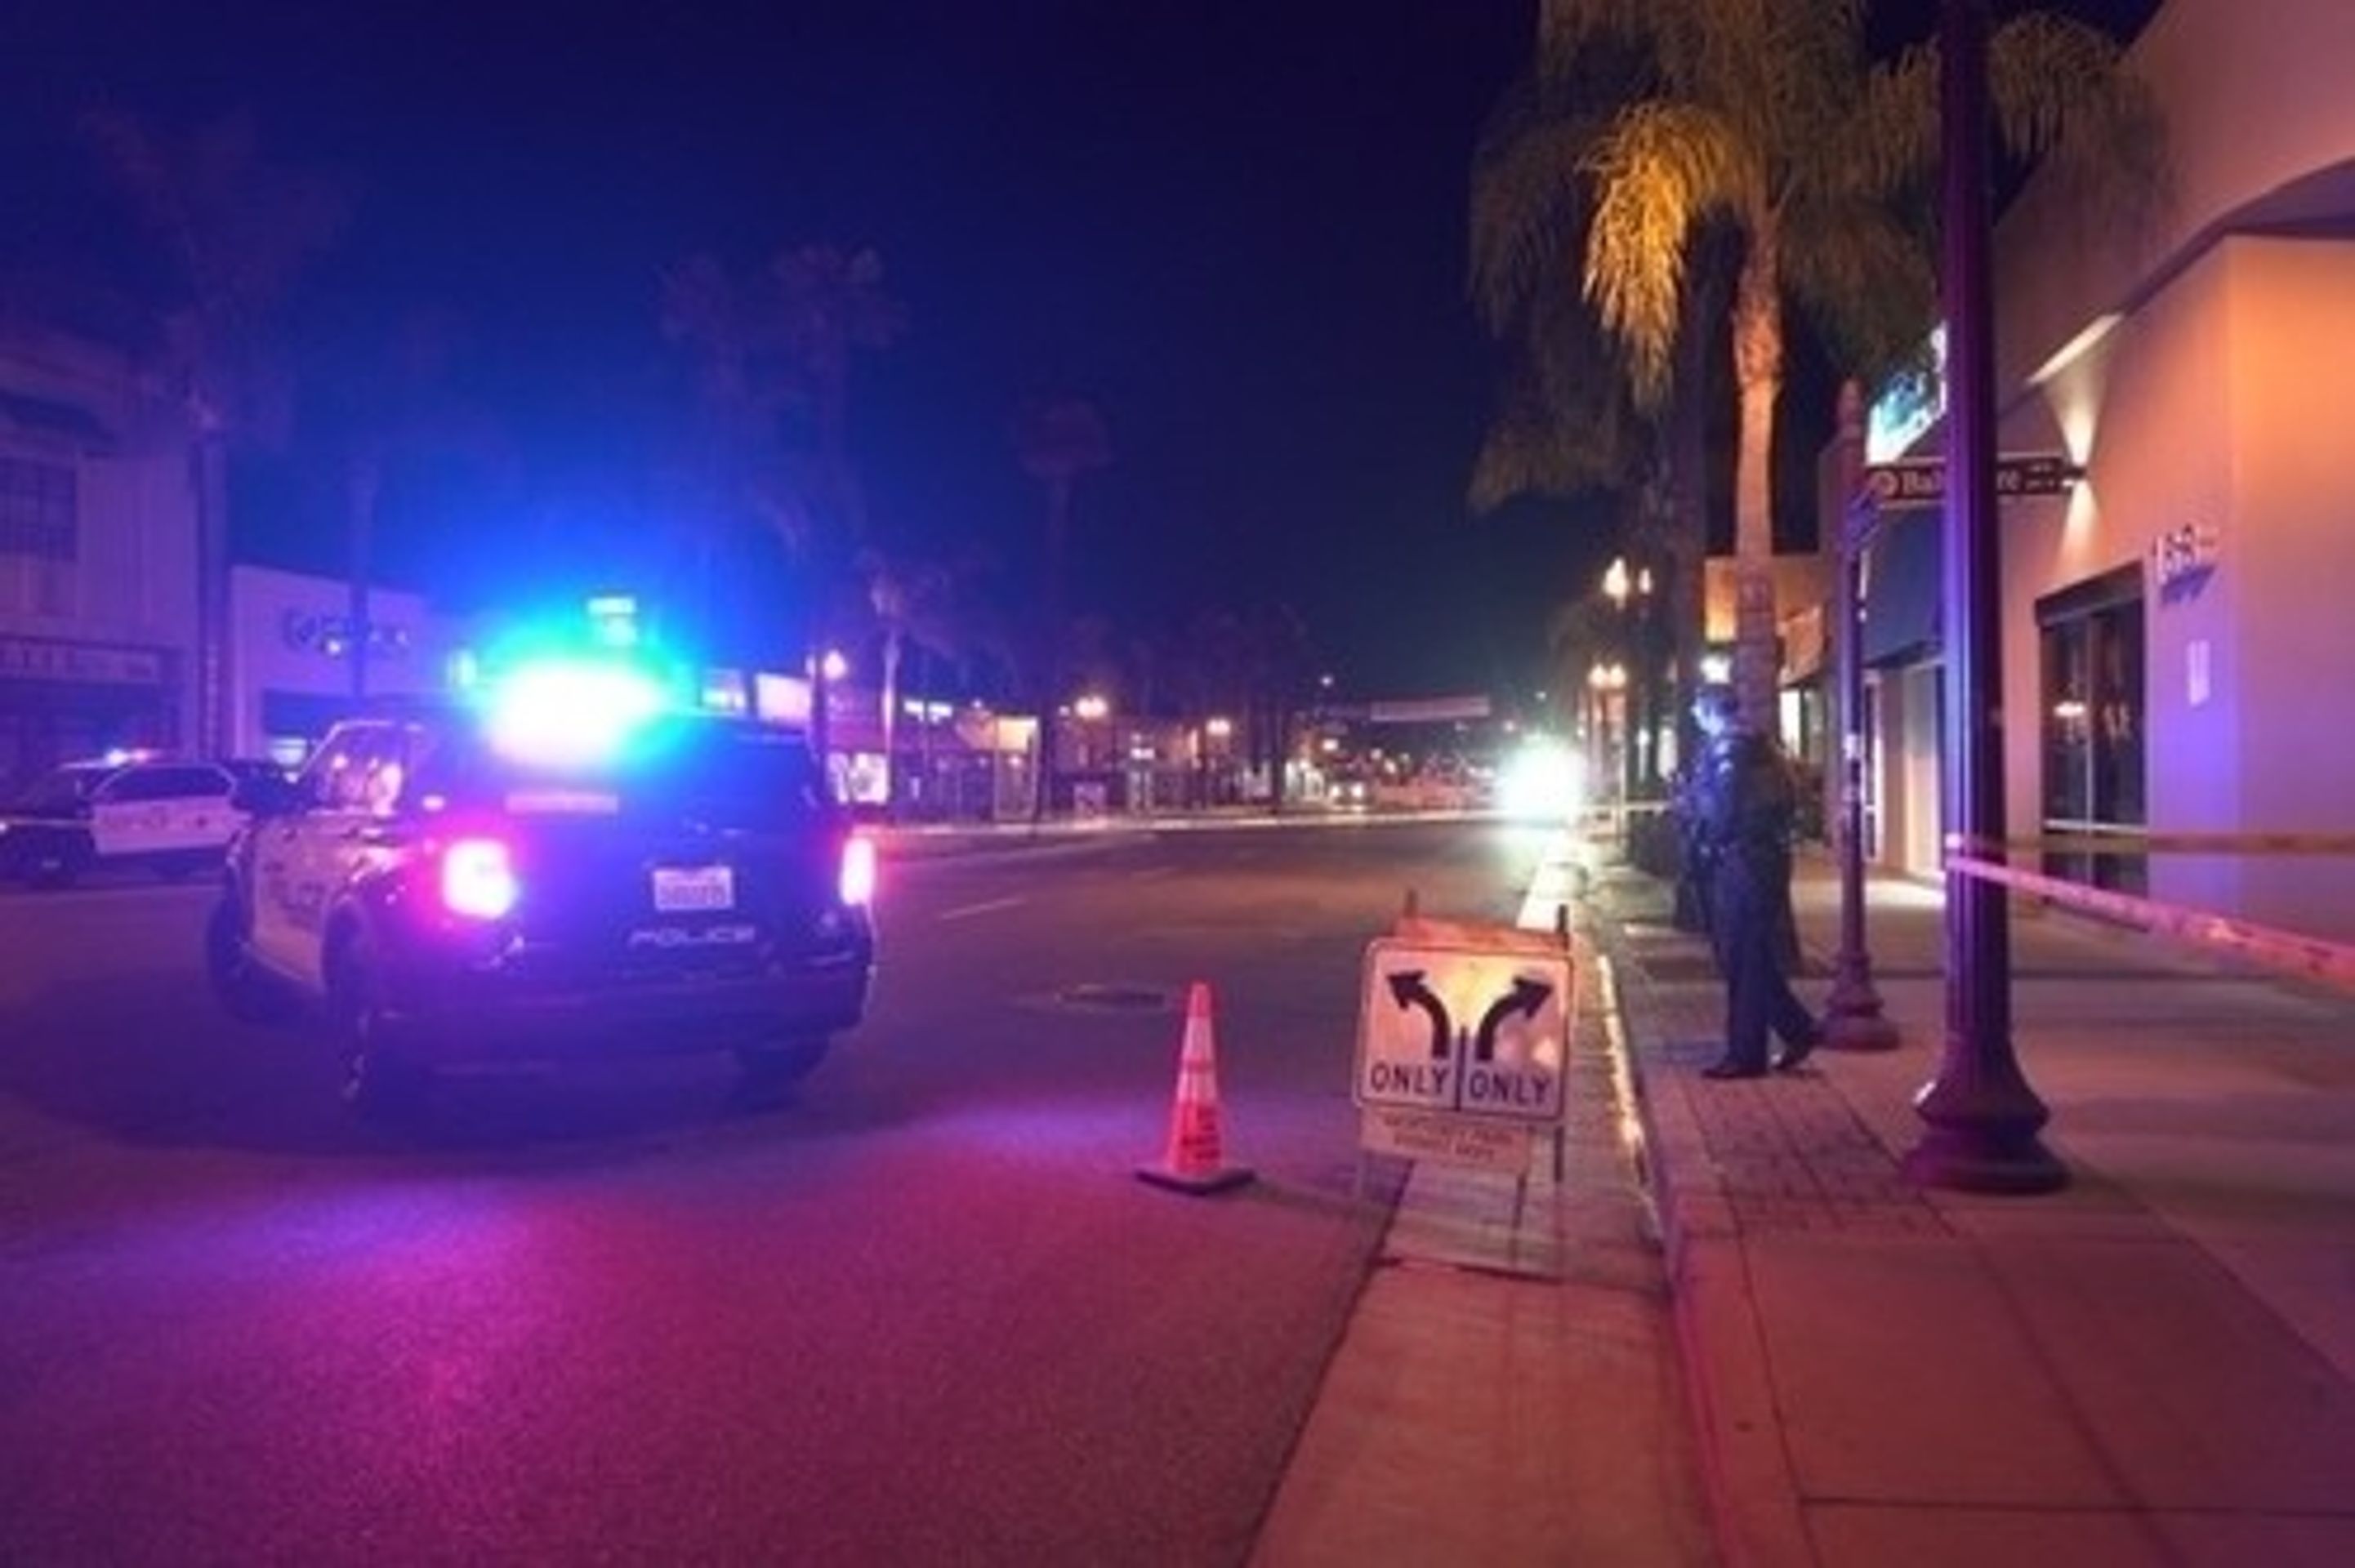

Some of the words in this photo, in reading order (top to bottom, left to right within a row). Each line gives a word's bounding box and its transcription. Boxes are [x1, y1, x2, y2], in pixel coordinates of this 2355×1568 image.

[628, 926, 756, 948] POLICE
[1371, 1063, 1450, 1095] ONLY
[1470, 1070, 1550, 1106] ONLY
